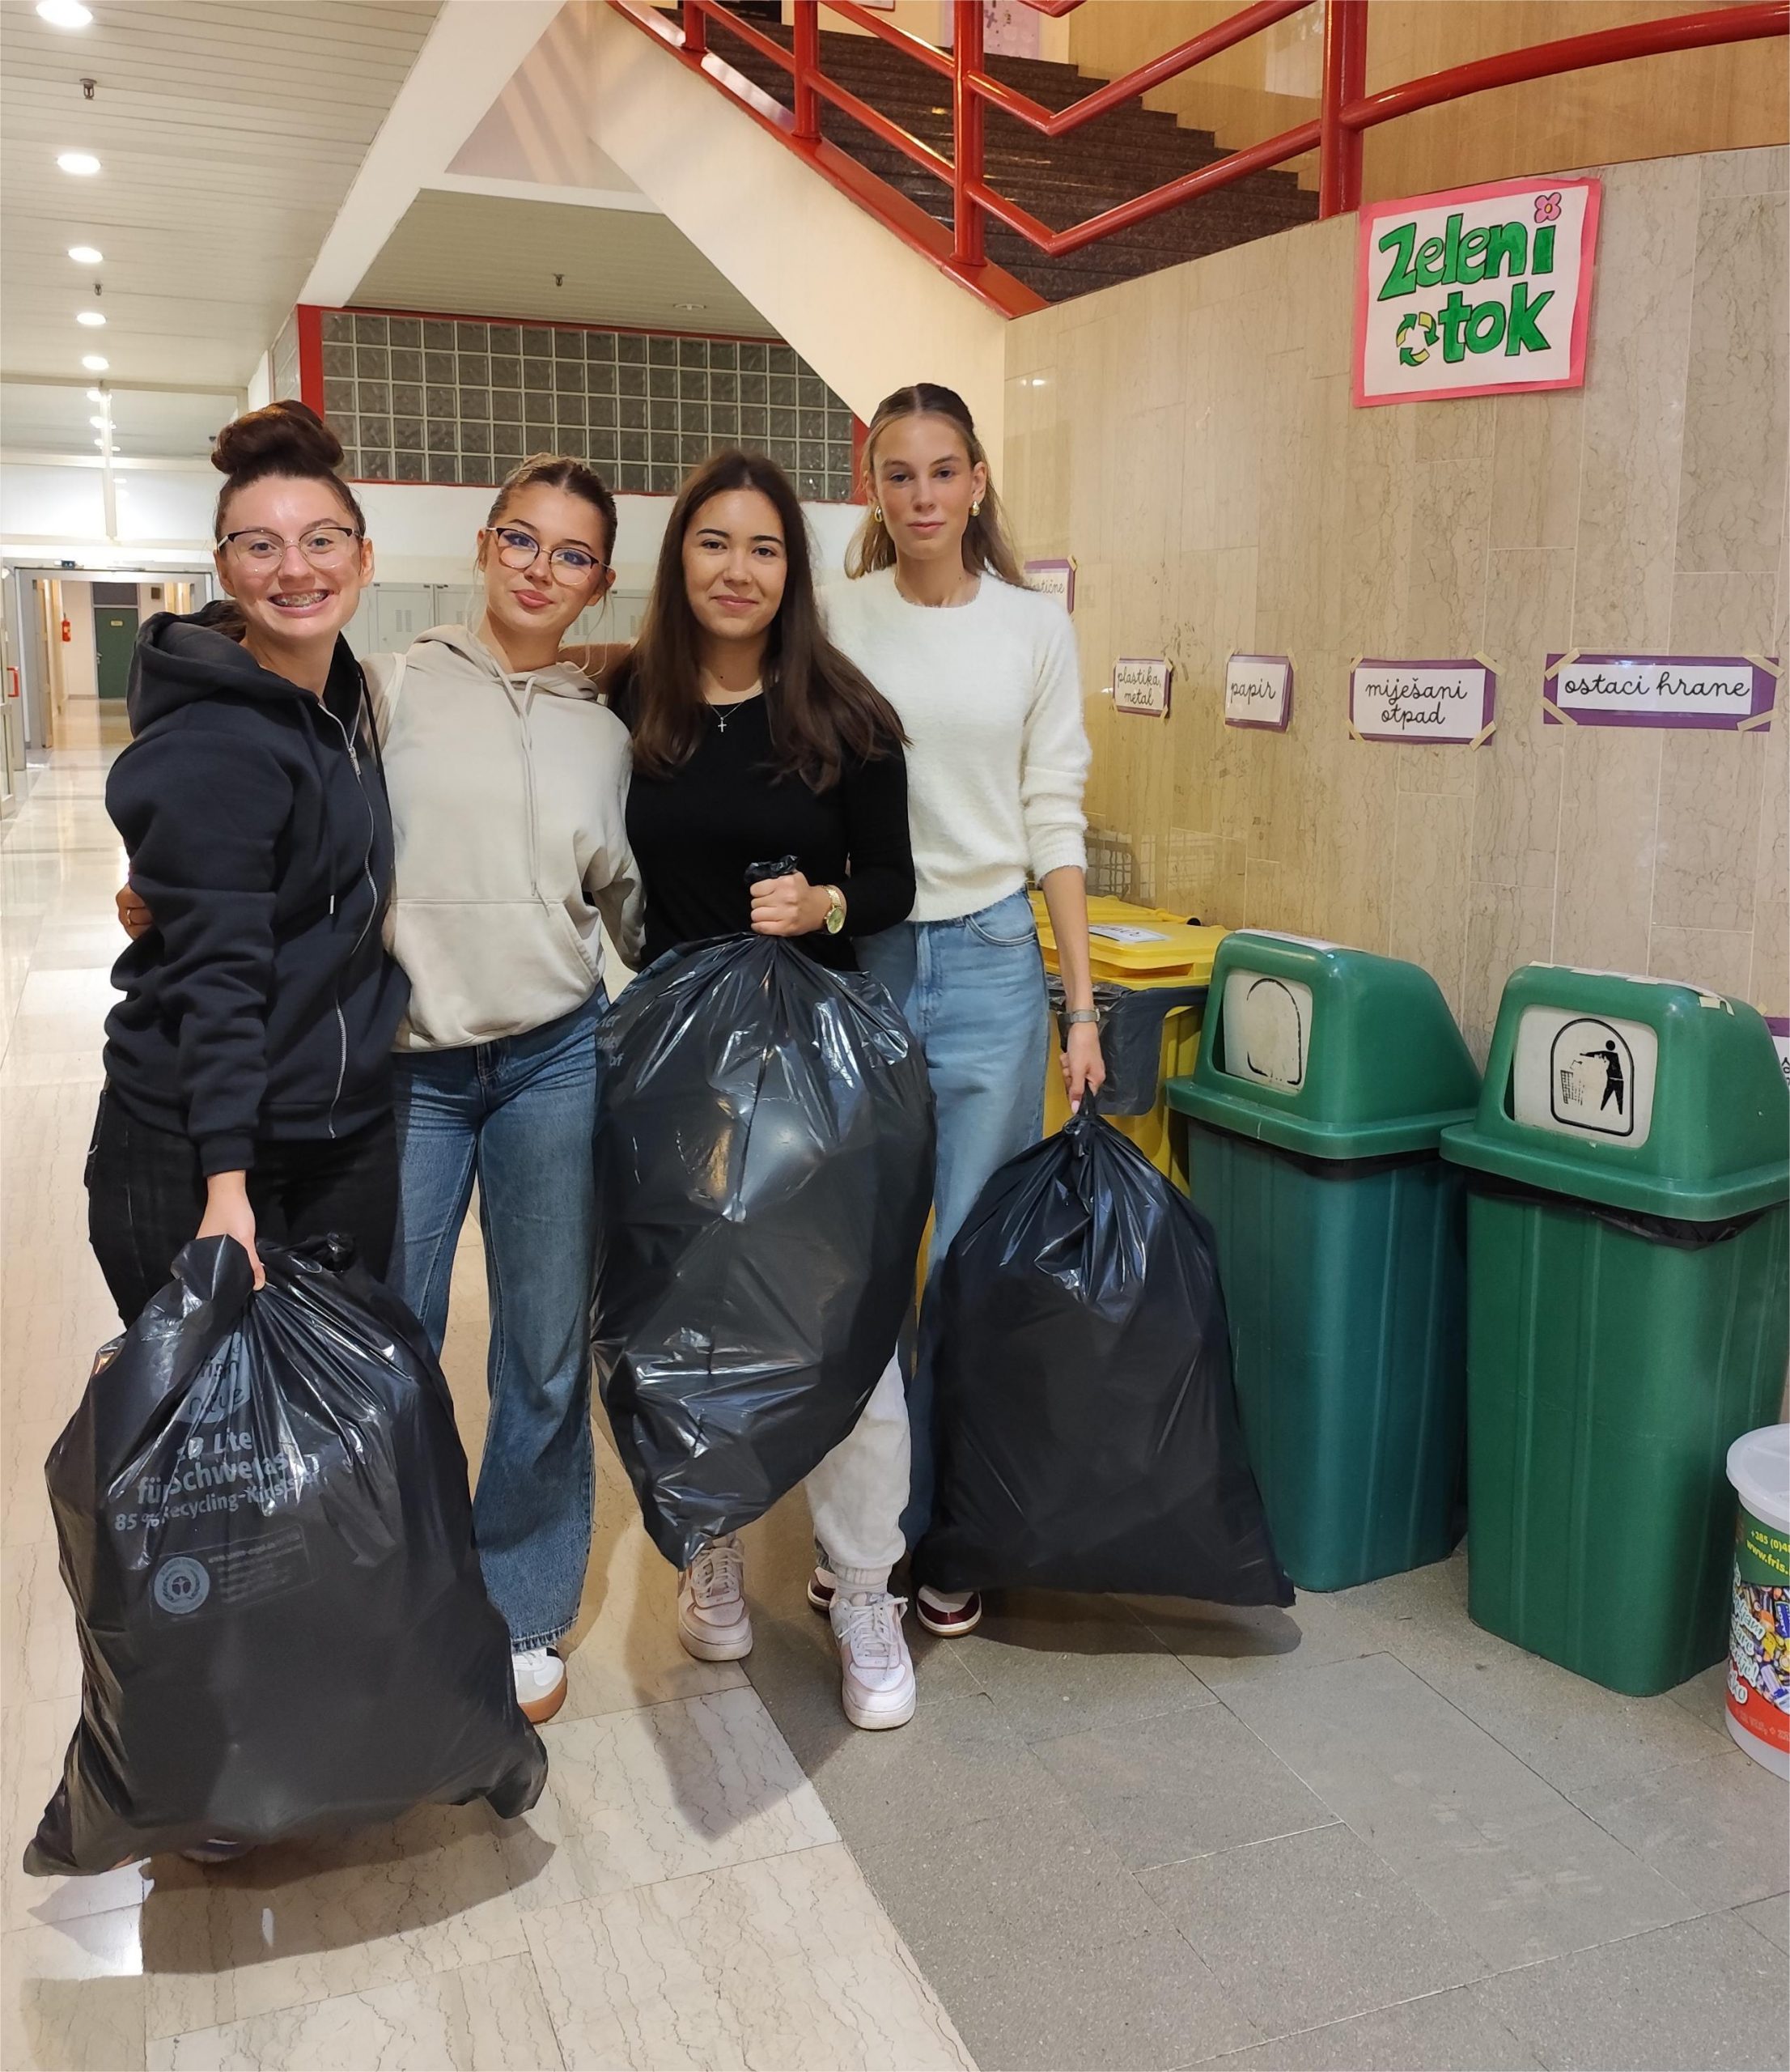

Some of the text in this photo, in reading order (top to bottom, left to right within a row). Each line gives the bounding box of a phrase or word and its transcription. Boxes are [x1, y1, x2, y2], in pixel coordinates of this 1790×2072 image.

[1377, 212, 1557, 301] Zeleni
[1124, 687, 1155, 707] metal
[1230, 677, 1276, 706] papir
[1365, 677, 1468, 706] miješani
[1564, 671, 1751, 697] ostaci hrane
[1381, 701, 1446, 731] otpad
[113, 1512, 138, 1531] 85
[1746, 1539, 1790, 1577] www.fris.
